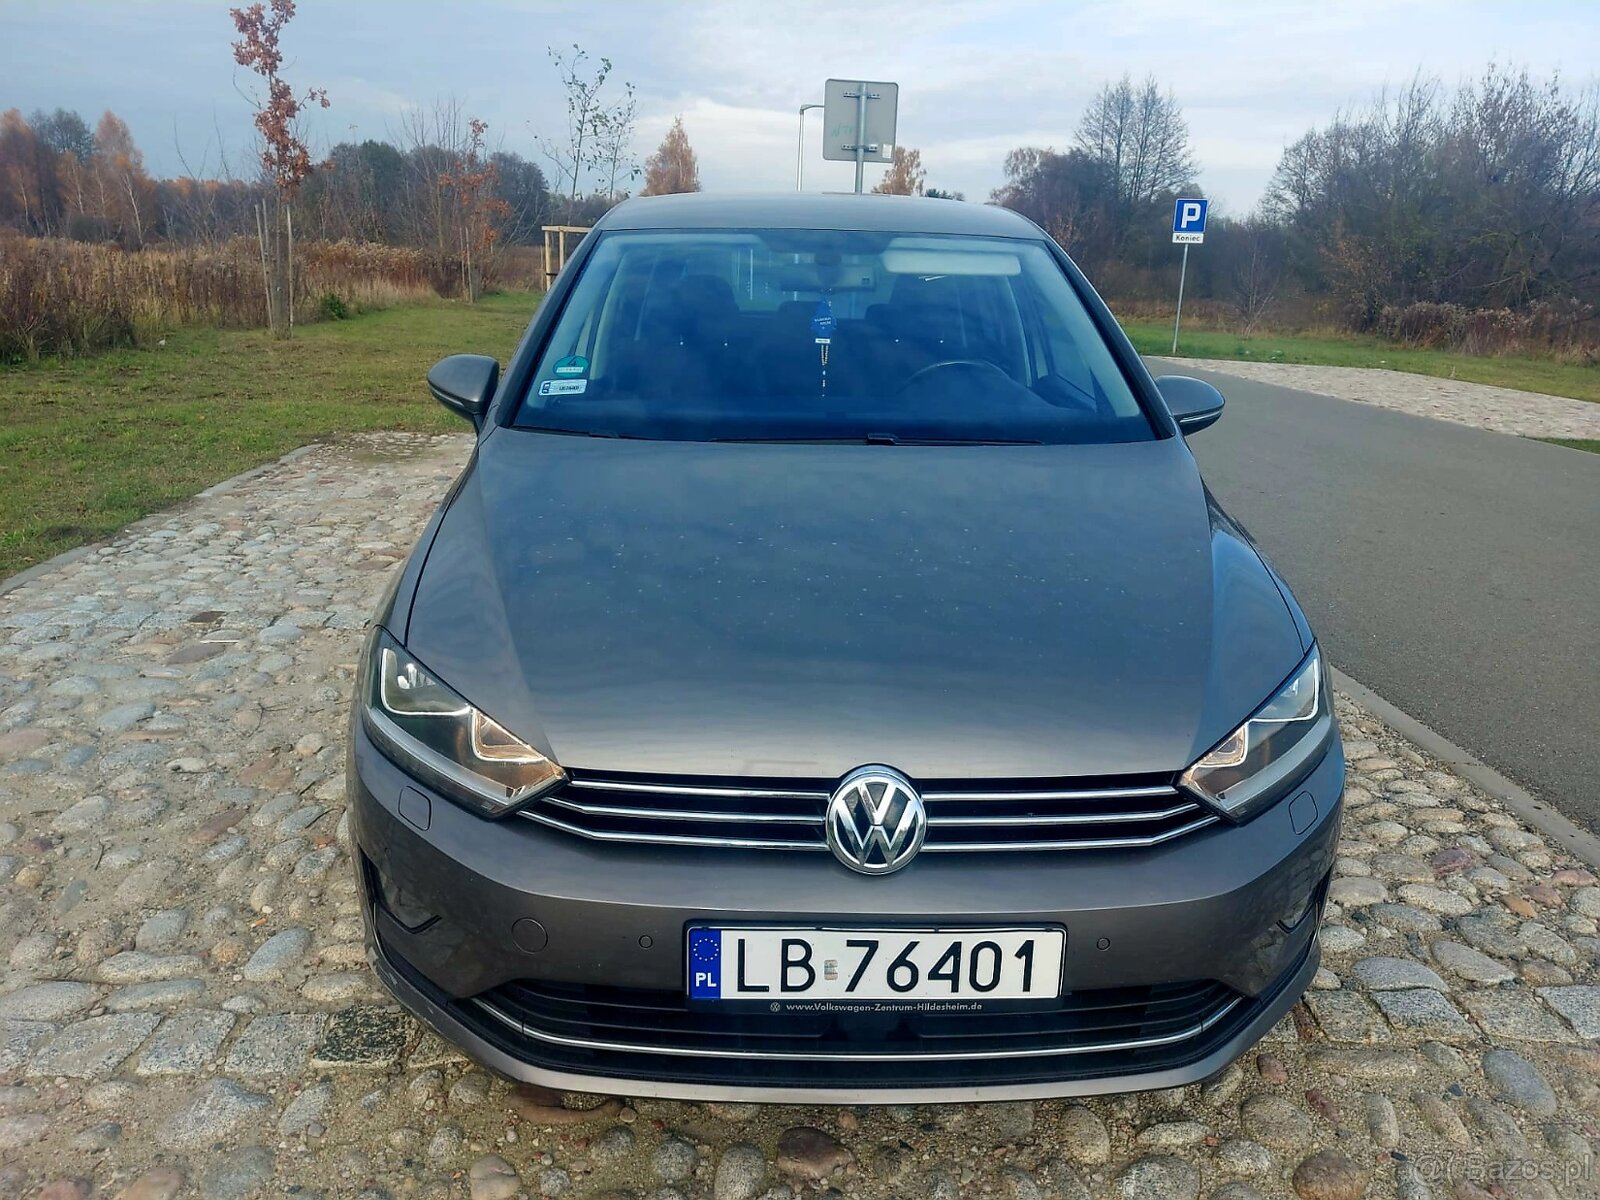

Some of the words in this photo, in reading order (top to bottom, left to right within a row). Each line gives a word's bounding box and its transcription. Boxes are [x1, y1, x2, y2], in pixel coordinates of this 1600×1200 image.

[1181, 203, 1201, 228] P
[737, 938, 816, 993] LB
[845, 939, 1035, 993] 76401
[695, 972, 717, 987] PL
[786, 1002, 983, 1013] www.Volkswagen-Zentrum-Hildesheim.de
